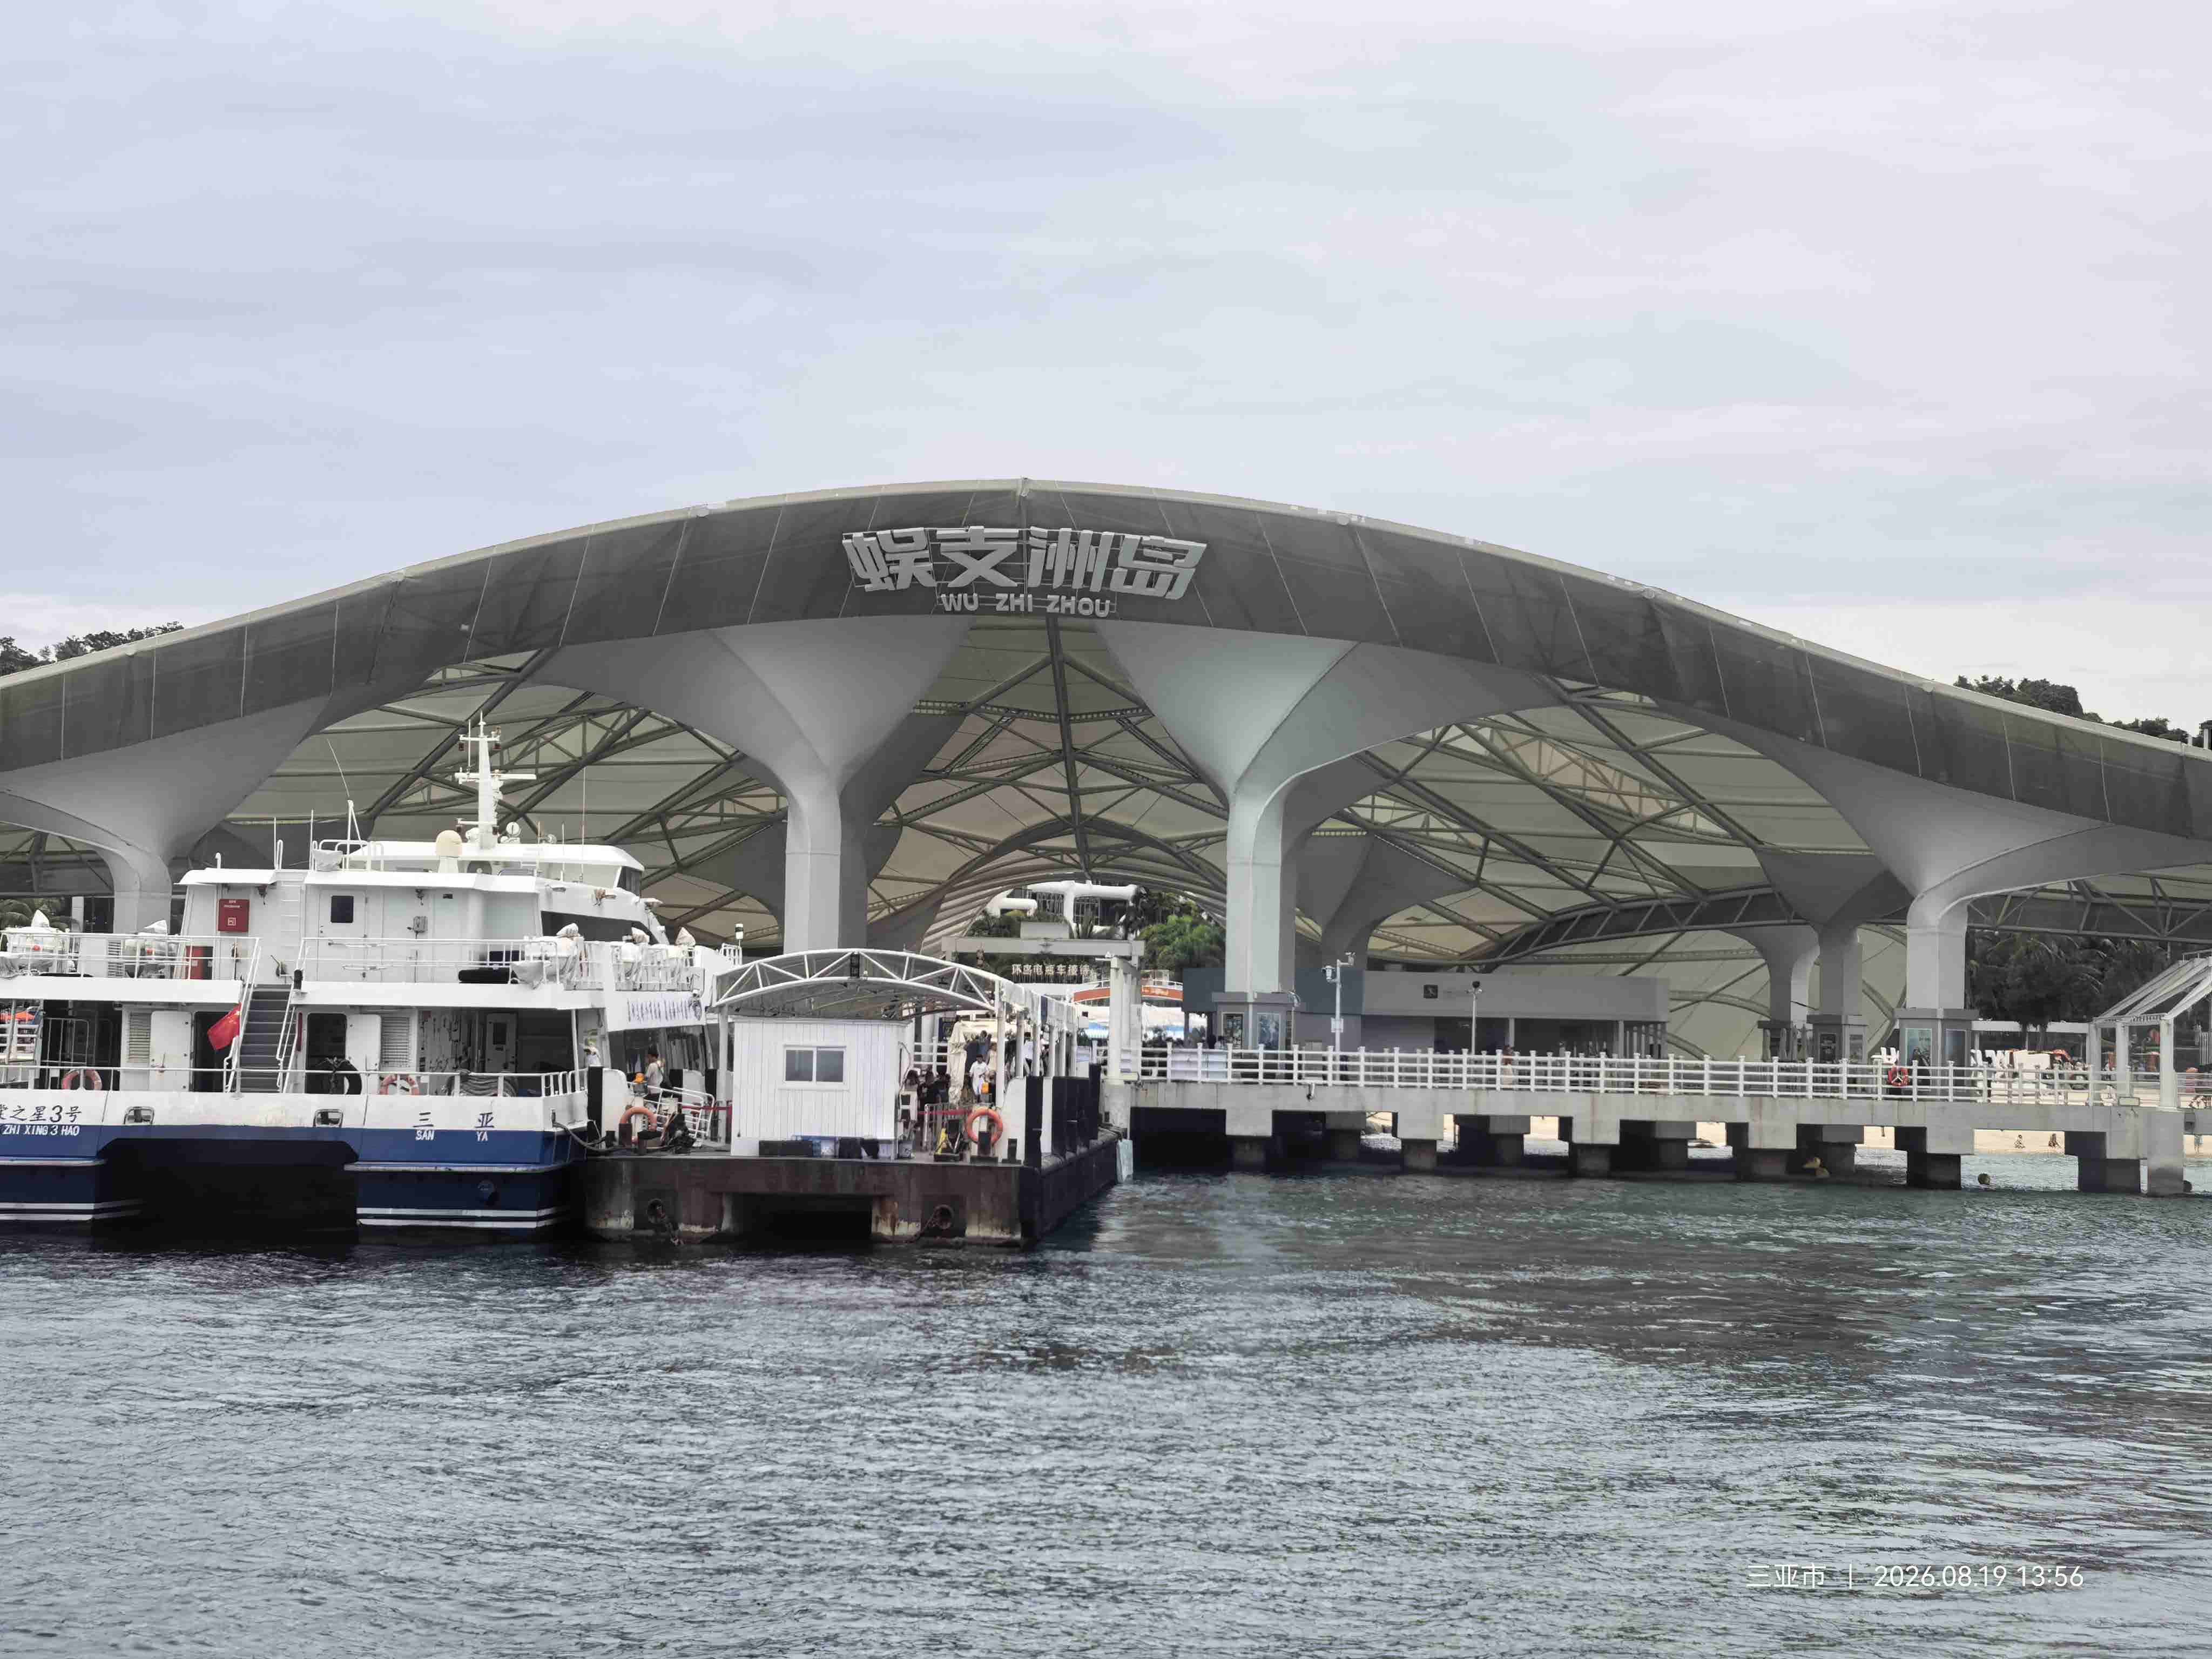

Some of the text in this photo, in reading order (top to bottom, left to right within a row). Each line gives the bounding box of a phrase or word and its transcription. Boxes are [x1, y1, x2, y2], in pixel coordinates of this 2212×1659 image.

[842, 526, 1207, 599] 蜈支洲岛
[941, 593, 1111, 618] WU ZHI ZHOU
[413, 1112, 494, 1128] 三 亚
[2, 1124, 80, 1136] ZHI XING 3 HAO
[415, 1130, 488, 1142] SAN YA
